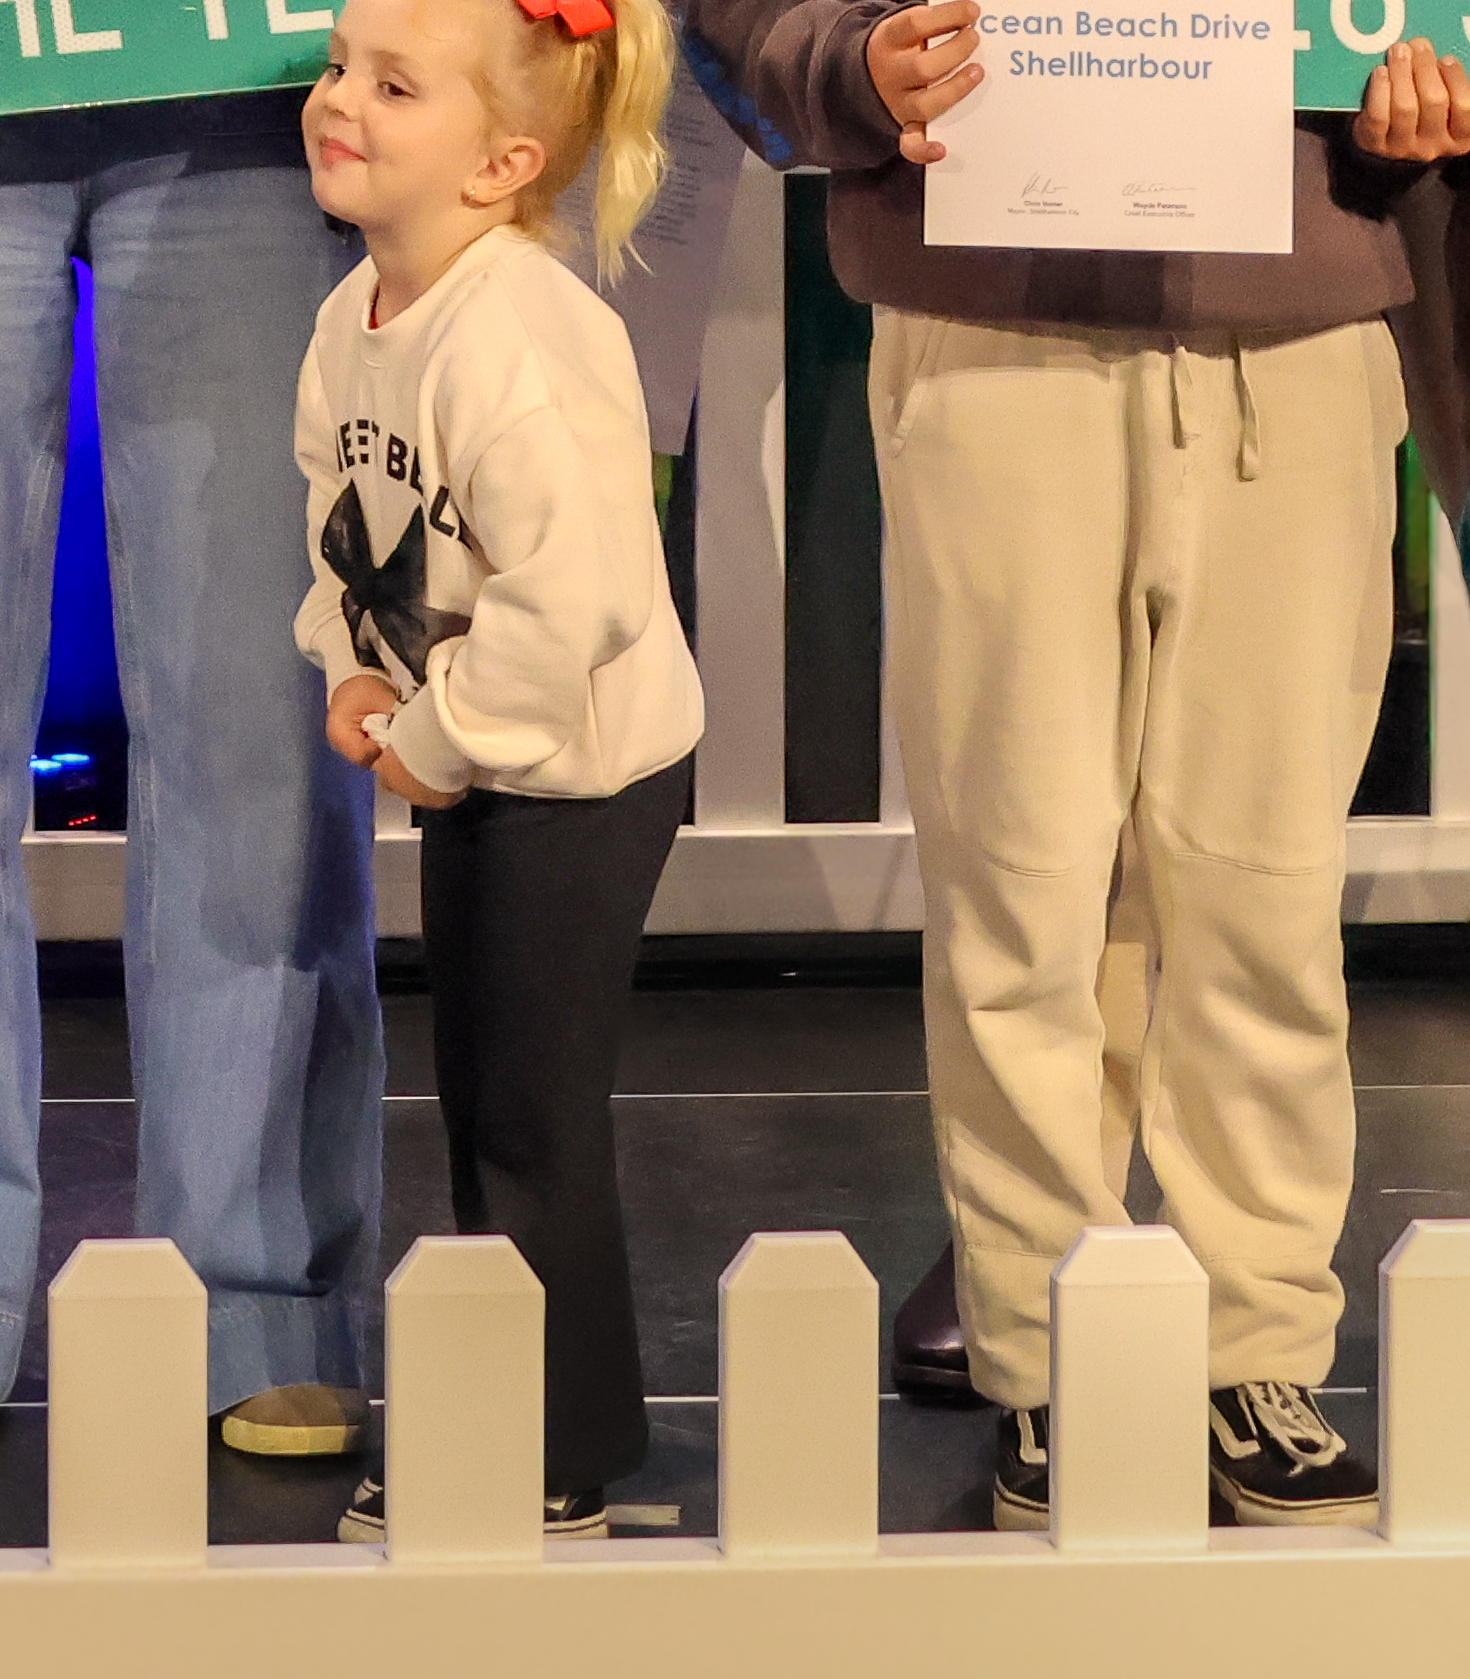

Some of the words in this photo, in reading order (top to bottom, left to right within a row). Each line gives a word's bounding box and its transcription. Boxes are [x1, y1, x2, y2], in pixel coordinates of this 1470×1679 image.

[976, 12, 1062, 34] cean
[1075, 12, 1178, 38] Beach
[1191, 15, 1270, 40] Drive
[1009, 51, 1212, 80] Shellharbour
